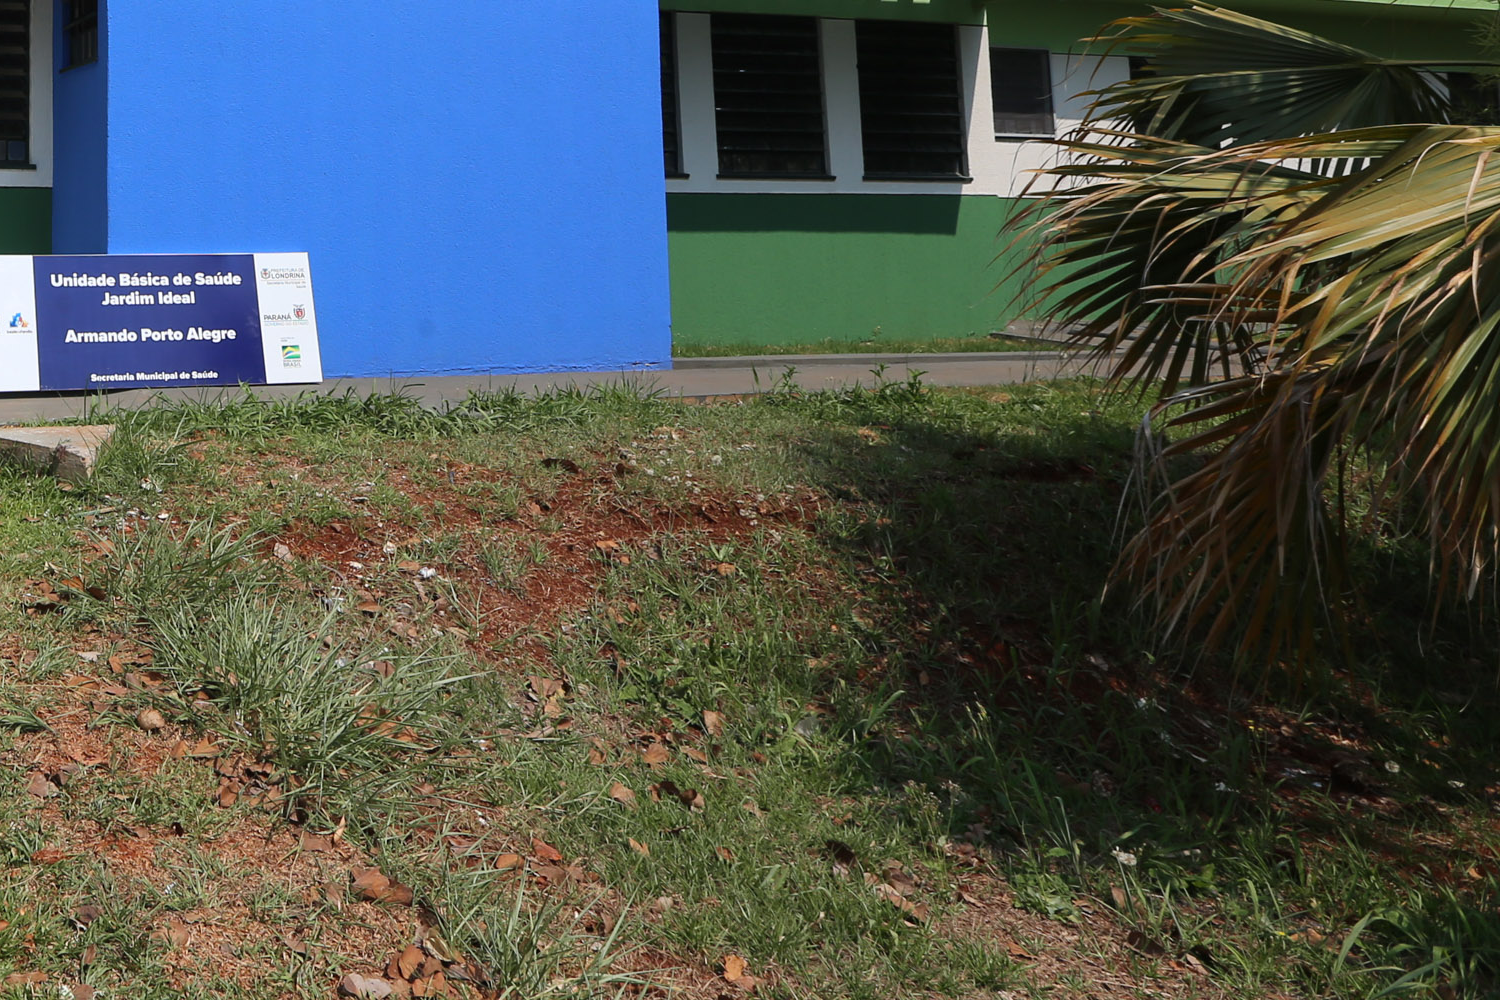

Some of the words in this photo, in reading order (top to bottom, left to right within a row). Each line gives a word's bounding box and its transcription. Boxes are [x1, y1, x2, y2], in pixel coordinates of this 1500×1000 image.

[50, 273, 116, 288] Unidade
[119, 272, 170, 287] Básica
[173, 272, 192, 286] de
[195, 271, 242, 286] Saúde
[101, 292, 155, 306] Jardim
[158, 291, 196, 305] Ideal
[64, 329, 138, 343] Armando
[141, 328, 183, 341] Porto
[186, 327, 237, 343] Alegre
[90, 373, 135, 382] Secretaria
[136, 371, 178, 382] Municipal
[179, 371, 190, 380] de
[191, 370, 218, 379] Saúde
